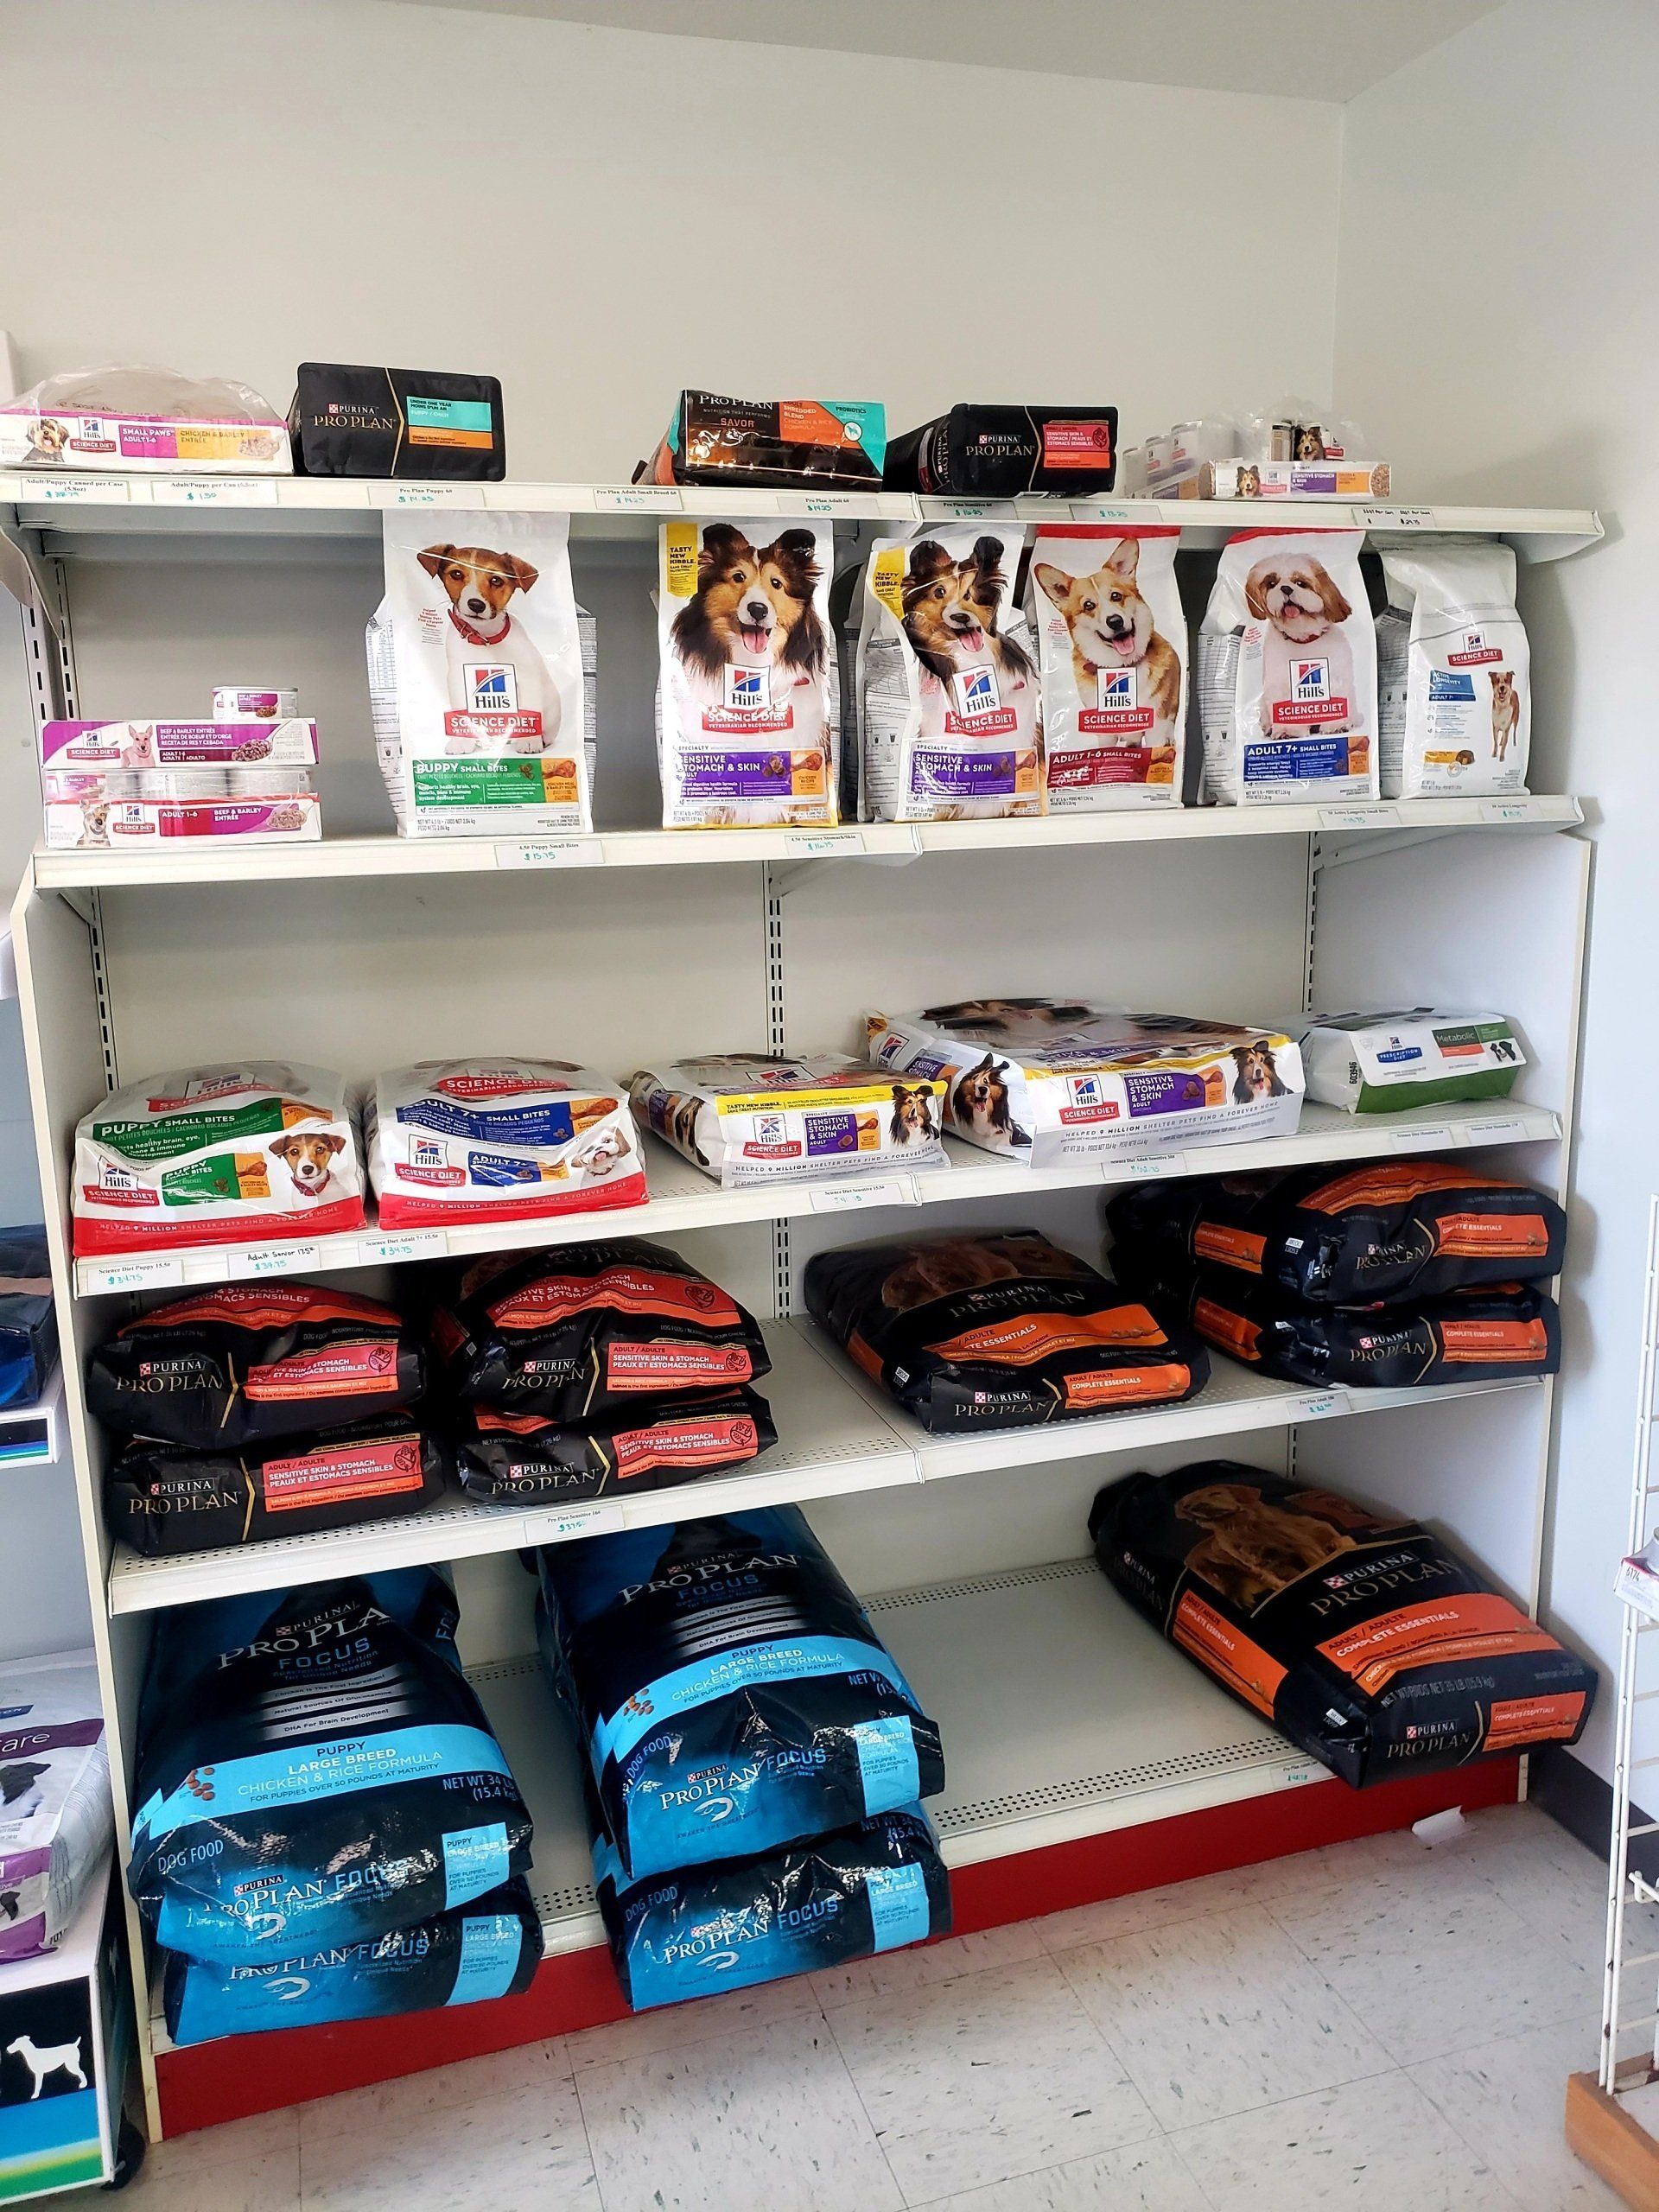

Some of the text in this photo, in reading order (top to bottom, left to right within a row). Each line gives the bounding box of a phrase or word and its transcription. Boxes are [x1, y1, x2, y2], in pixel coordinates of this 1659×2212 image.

[339, 405, 375, 414] PURINA
[314, 415, 393, 429] PRO PLAN
[721, 418, 754, 429] SAVOR
[965, 445, 1033, 457] PRO PLAN
[1298, 686, 1325, 699] Hill's
[475, 695, 511, 709] Hill's
[731, 693, 763, 707] Hill's
[965, 694, 996, 713] Hill's
[1103, 694, 1132, 709] Hill's
[1278, 703, 1344, 716] SCIENCE DIET
[1084, 714, 1150, 725] SCIENCE DIET
[1247, 747, 1283, 756] ADULT
[1286, 745, 1299, 754] 7+
[916, 754, 963, 765] SENSITIVE
[737, 763, 760, 772] SKIN
[1437, 1031, 1476, 1044] Metabolic
[1349, 1061, 1357, 1085] 603946
[1128, 1075, 1174, 1087] SENSITIVE
[1130, 1082, 1175, 1096] STOMACH
[1075, 1094, 1099, 1106] Hill's
[1132, 1091, 1163, 1103] & SKIN
[1064, 1106, 1116, 1119] SCIENCE DIET
[165, 1118, 202, 1127] SMALL
[204, 1115, 236, 1123] BITES
[807, 1116, 849, 1127] SENSITIVE
[808, 1122, 849, 1133] STOMACH
[817, 1130, 837, 1140] SKIN
[415, 1154, 442, 1166] Hill's
[398, 1168, 461, 1181] SCIENCE DIET
[105, 1176, 131, 1189] Hill's
[88, 1190, 154, 1200] SCIENCE DIET
[153, 1361, 203, 1373] PURINA
[649, 1361, 688, 1370] ESTOMACS
[689, 1362, 726, 1371] SENSIBLES
[985, 1390, 1029, 1403] PURINA
[270, 1464, 394, 1488] PEAUX ET ESTOMACS SENSIBLES
[160, 1479, 213, 1494] PURINA
[129, 1491, 239, 1514] PRO PLAN
[1343, 1551, 1415, 1584] PURINA
[616, 1553, 798, 1605] PRO PLAN
[1336, 1610, 1459, 1658] COMPLETE ESSENTIALS
[216, 1637, 300, 1671] PRO
[278, 1636, 372, 1671] FOCUS
[731, 1644, 774, 1659] PUPPY
[709, 1649, 804, 1676] LARGE BREED
[670, 1652, 845, 1702] CHICKEN & RICE FORMULA
[683, 1661, 844, 1704] FOR PUPPIES OVER 50 POUNDS AT MATURITY
[848, 1673, 869, 1688] NET
[283, 1707, 391, 1733] DHA For Brain Development
[1417, 1720, 1457, 1737] PURINA
[315, 1739, 366, 1758] PUPPY
[288, 1746, 397, 1777] LARGE BREED
[237, 1749, 443, 1797] CHICKEN & RICE FORMULA
[694, 1764, 728, 1780] PURINA
[251, 1761, 442, 1803] FOR PUPPIES OVER 50 POUNDS AT MATURITY
[442, 1773, 501, 1791] NET WT 34
[158, 1838, 226, 1873] DOG FOOD
